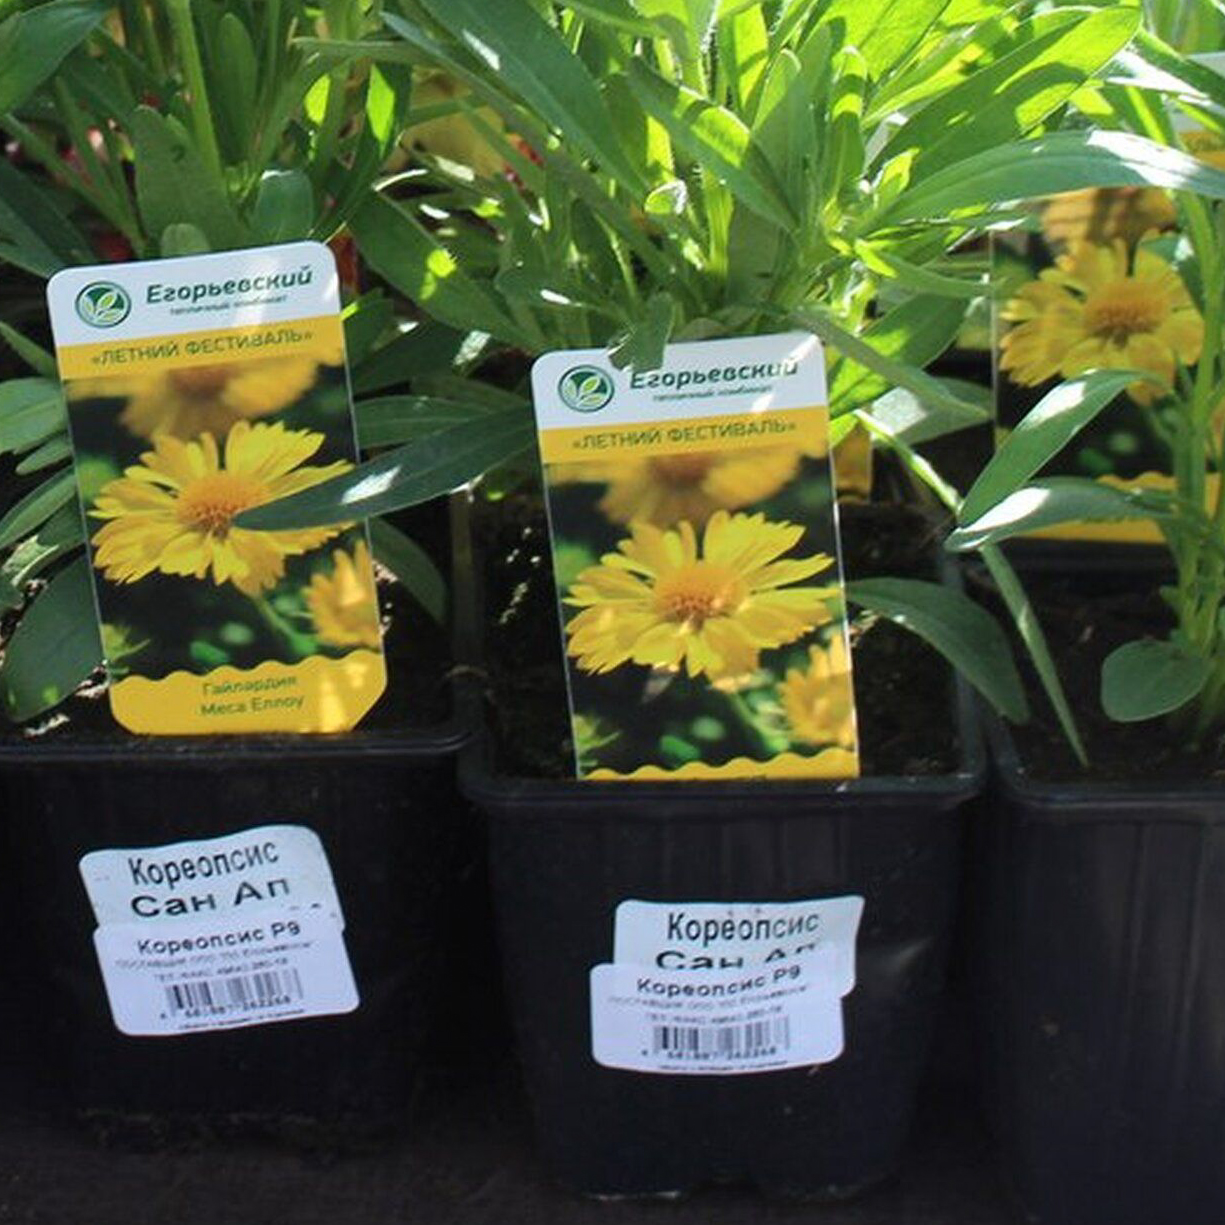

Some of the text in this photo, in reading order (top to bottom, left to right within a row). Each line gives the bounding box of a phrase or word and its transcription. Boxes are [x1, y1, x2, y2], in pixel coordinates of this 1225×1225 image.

[145, 265, 313, 304] Егорьевский
[629, 358, 799, 392] Егорьевский
[127, 840, 280, 891] Кореопсис
[130, 878, 291, 918] Сан Ап
[136, 925, 266, 957] Кореопсис
[666, 911, 821, 949] Кореопсис
[635, 975, 767, 1000] Кореопсис
